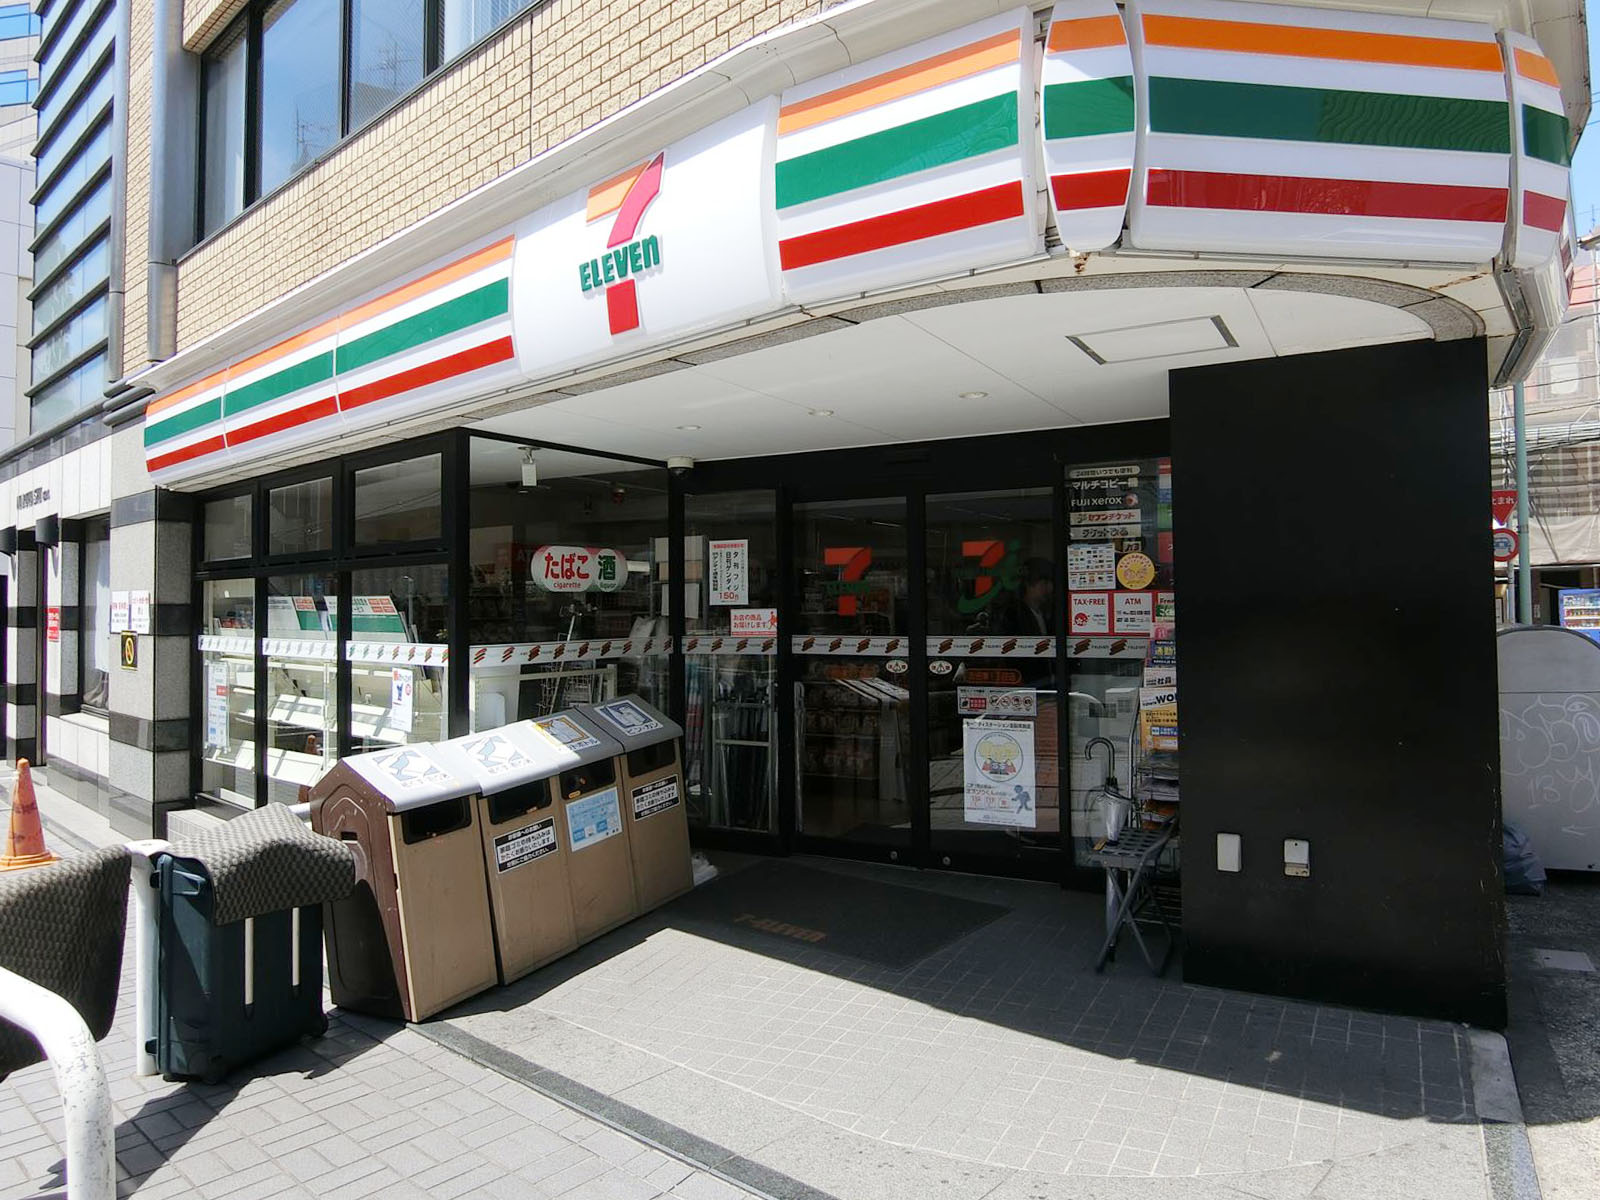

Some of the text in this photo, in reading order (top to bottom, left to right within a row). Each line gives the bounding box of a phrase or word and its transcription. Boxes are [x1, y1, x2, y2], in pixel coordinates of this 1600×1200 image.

[586, 151, 665, 336] 7
[544, 552, 617, 581] たばこ 酒
[1124, 597, 1142, 606] ATM
